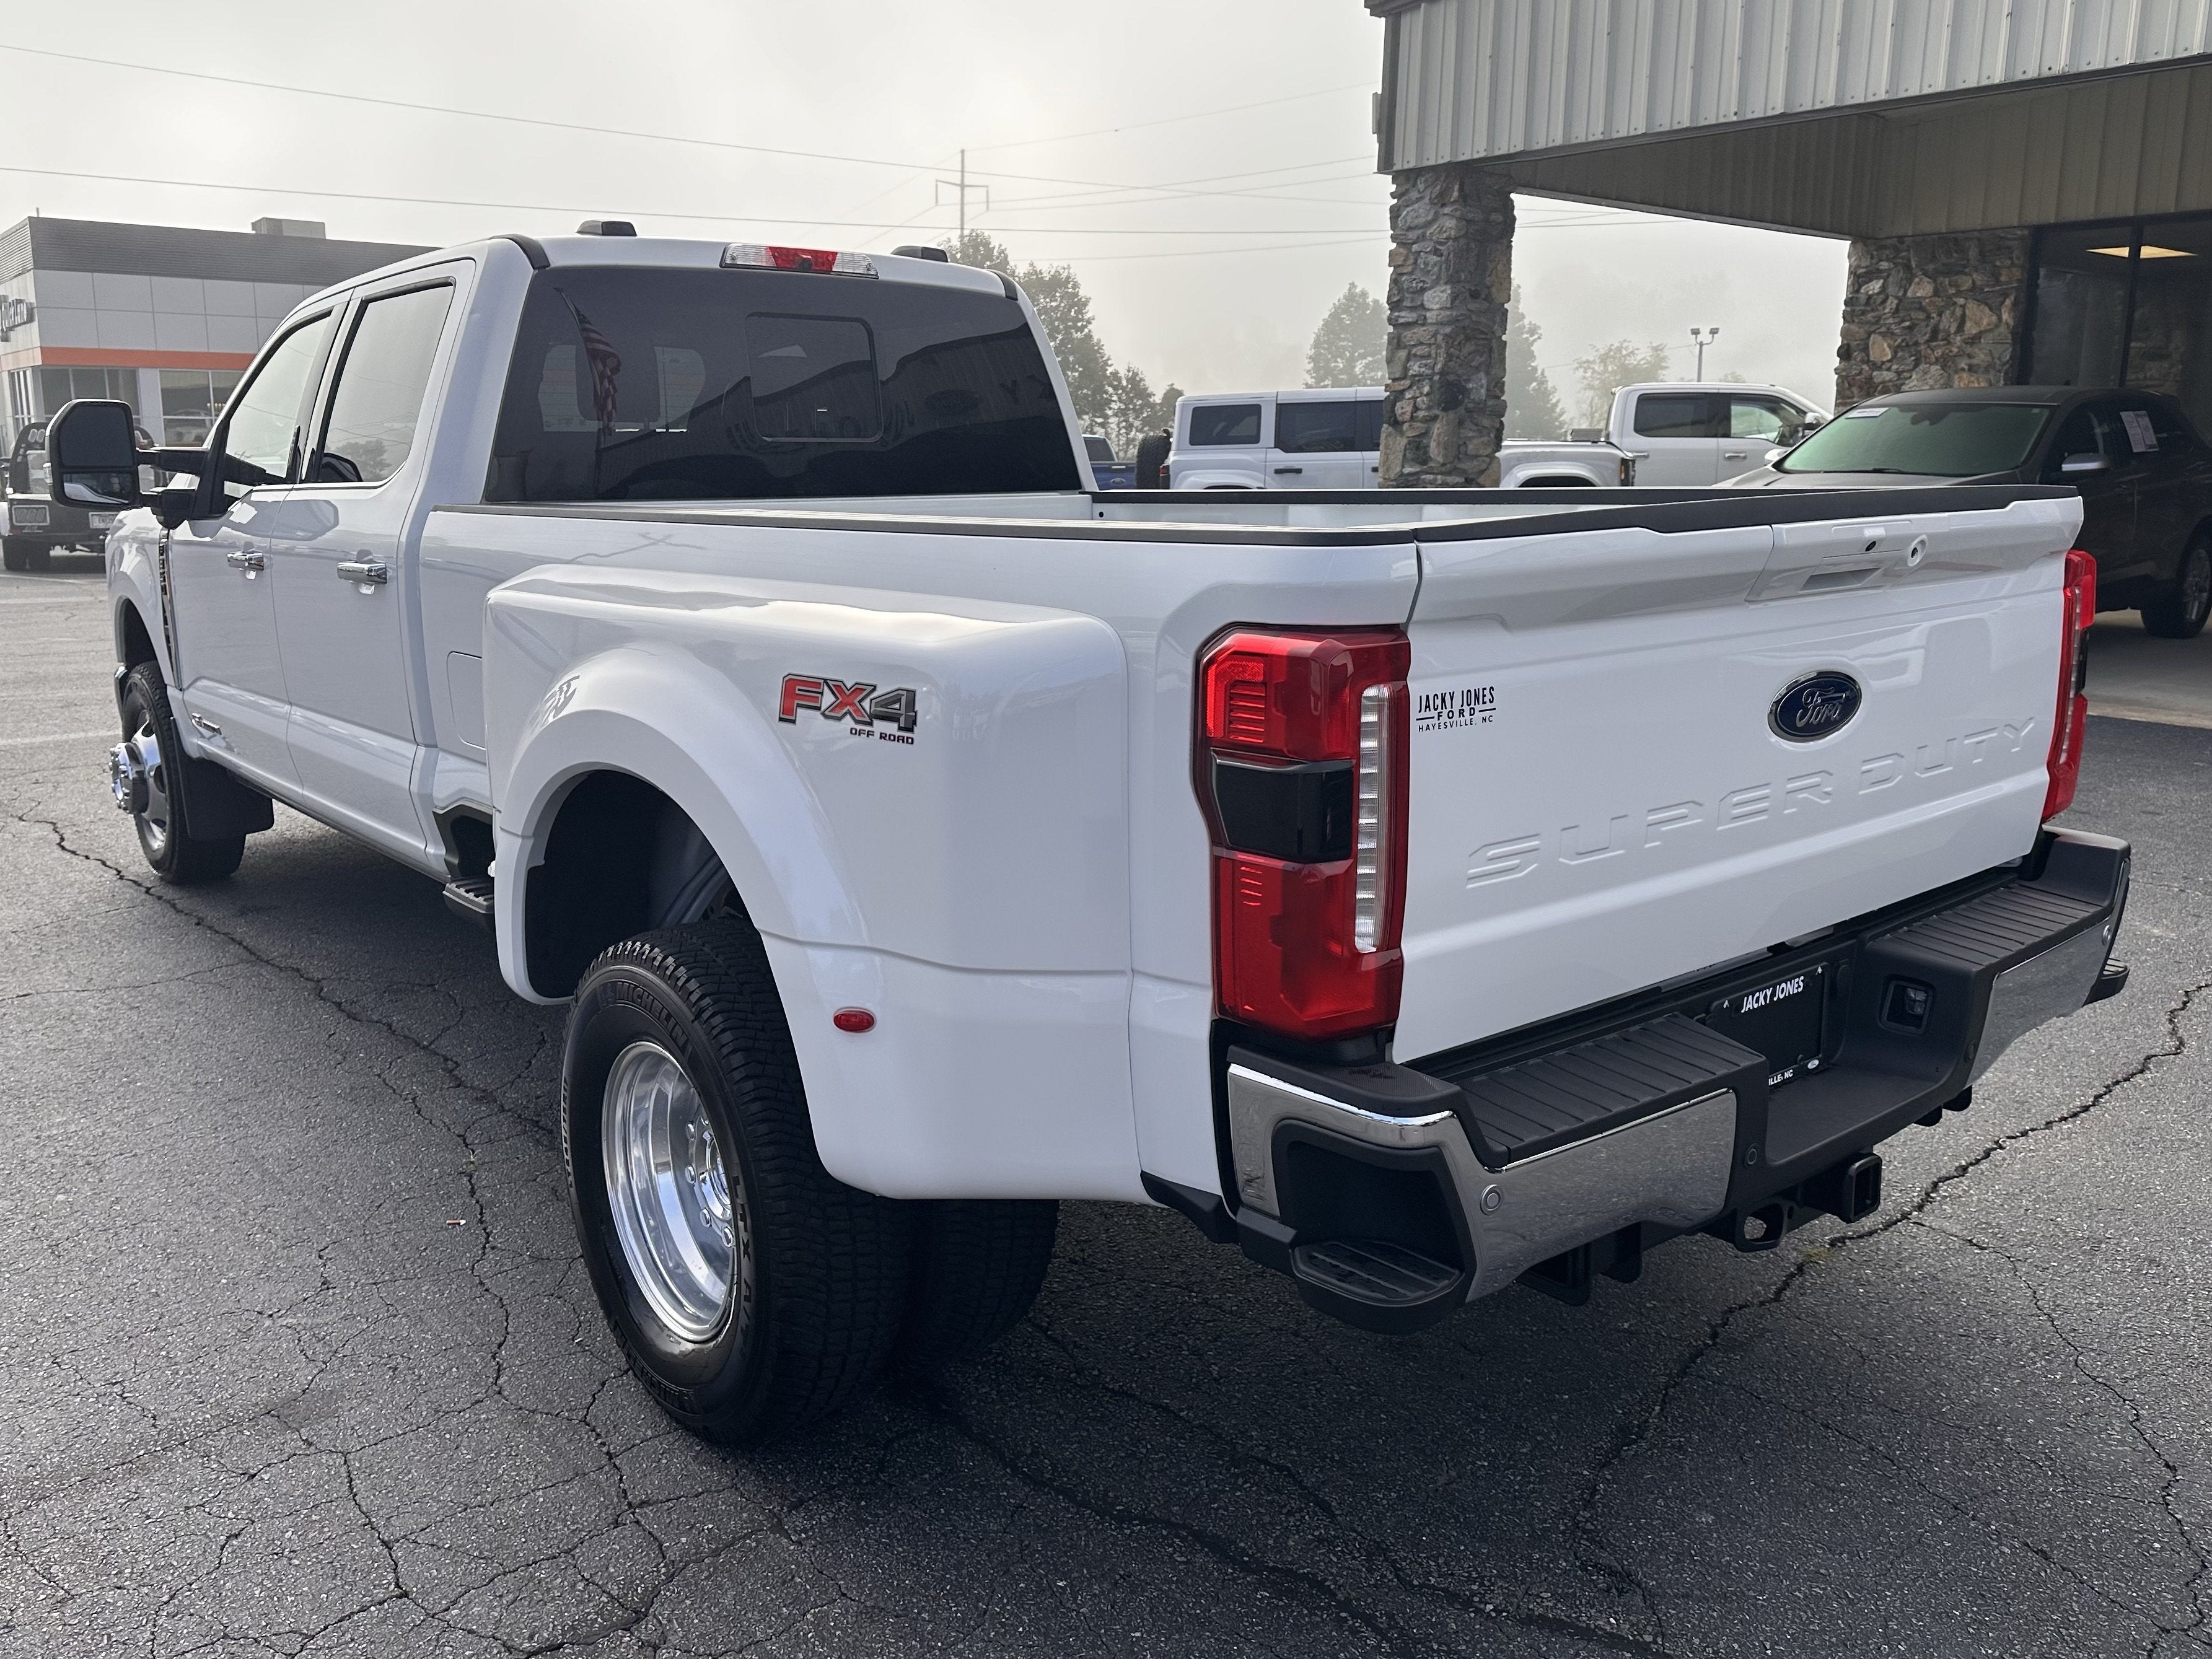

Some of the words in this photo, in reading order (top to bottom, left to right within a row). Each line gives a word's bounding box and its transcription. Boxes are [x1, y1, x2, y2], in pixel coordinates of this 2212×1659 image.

[778, 672, 918, 734] FX4
[1418, 691, 1455, 714] JACKY
[1460, 686, 1494, 708] JONES
[1437, 707, 1476, 721] FORD
[1796, 687, 1846, 728] Ford
[849, 727, 875, 738] OFF
[879, 732, 915, 745] ROAD
[1418, 717, 1477, 732] HAYESVILLE,
[1481, 715, 1494, 724] NC
[1466, 769, 1834, 890] SUPER
[1858, 717, 2036, 795] DUTY
[1740, 987, 1773, 1013] JACKY
[1773, 975, 1805, 1002] JONES
[615, 981, 690, 1048] MICHELIN
[1768, 1073, 1783, 1086] ILLE,
[1784, 1069, 1794, 1079] NC
[732, 1175, 752, 1263] LTX
